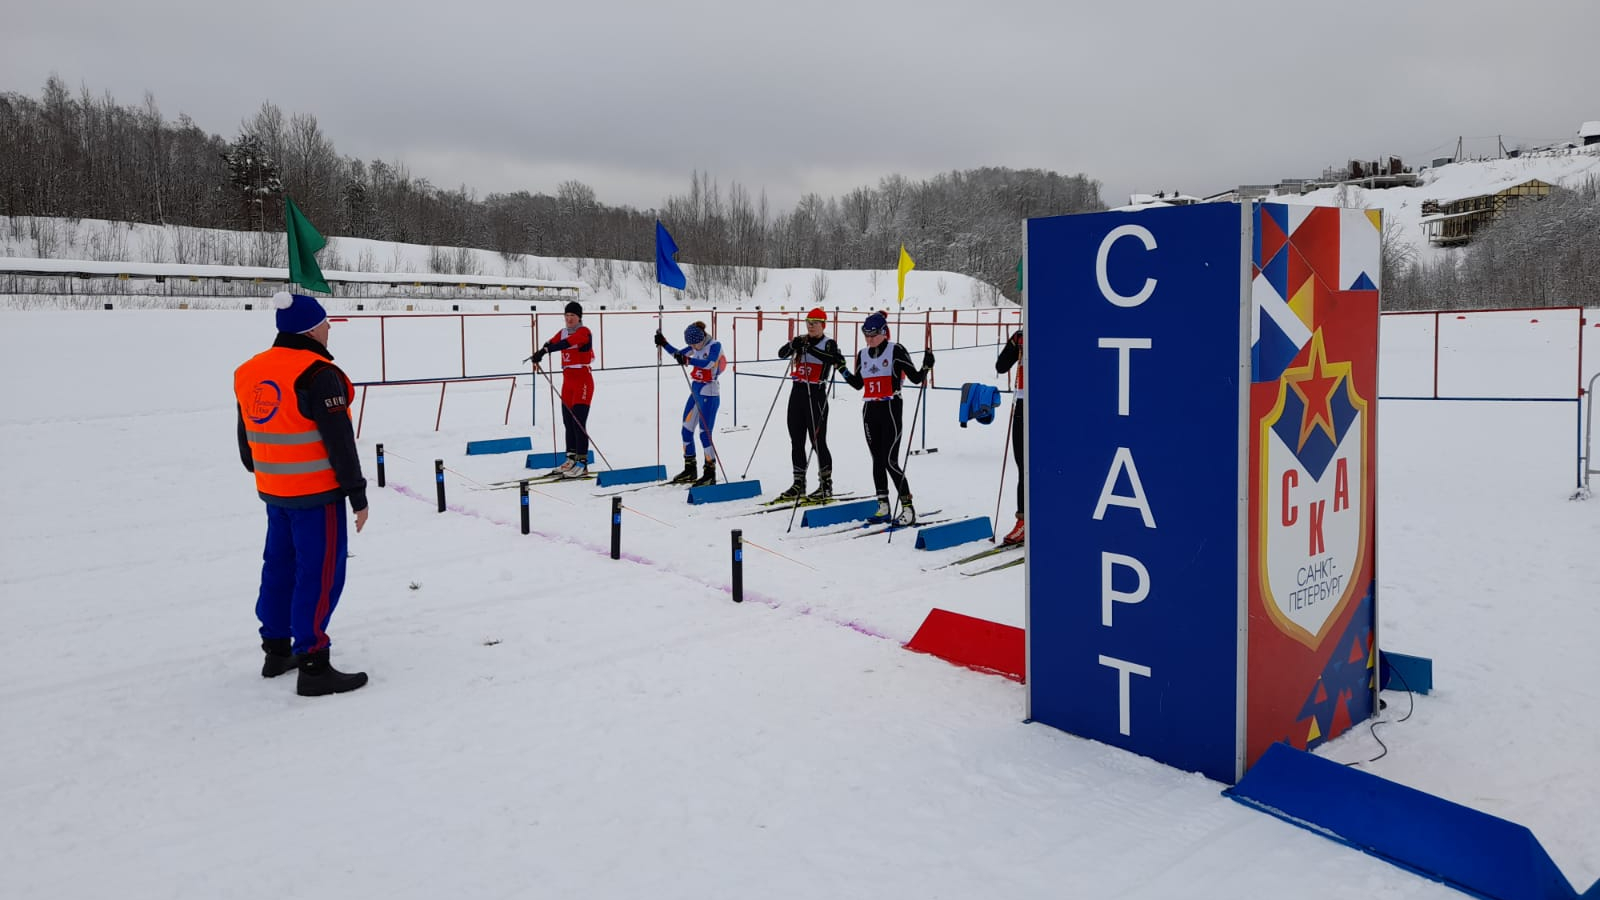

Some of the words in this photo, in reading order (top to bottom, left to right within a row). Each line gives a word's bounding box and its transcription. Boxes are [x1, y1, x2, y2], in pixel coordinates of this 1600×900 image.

[869, 380, 881, 393] 51
[1092, 224, 1159, 736] СТАРТ
[1296, 557, 1337, 587] САНКТ-
[1288, 575, 1344, 613] ПЕТЕРБУРГ
